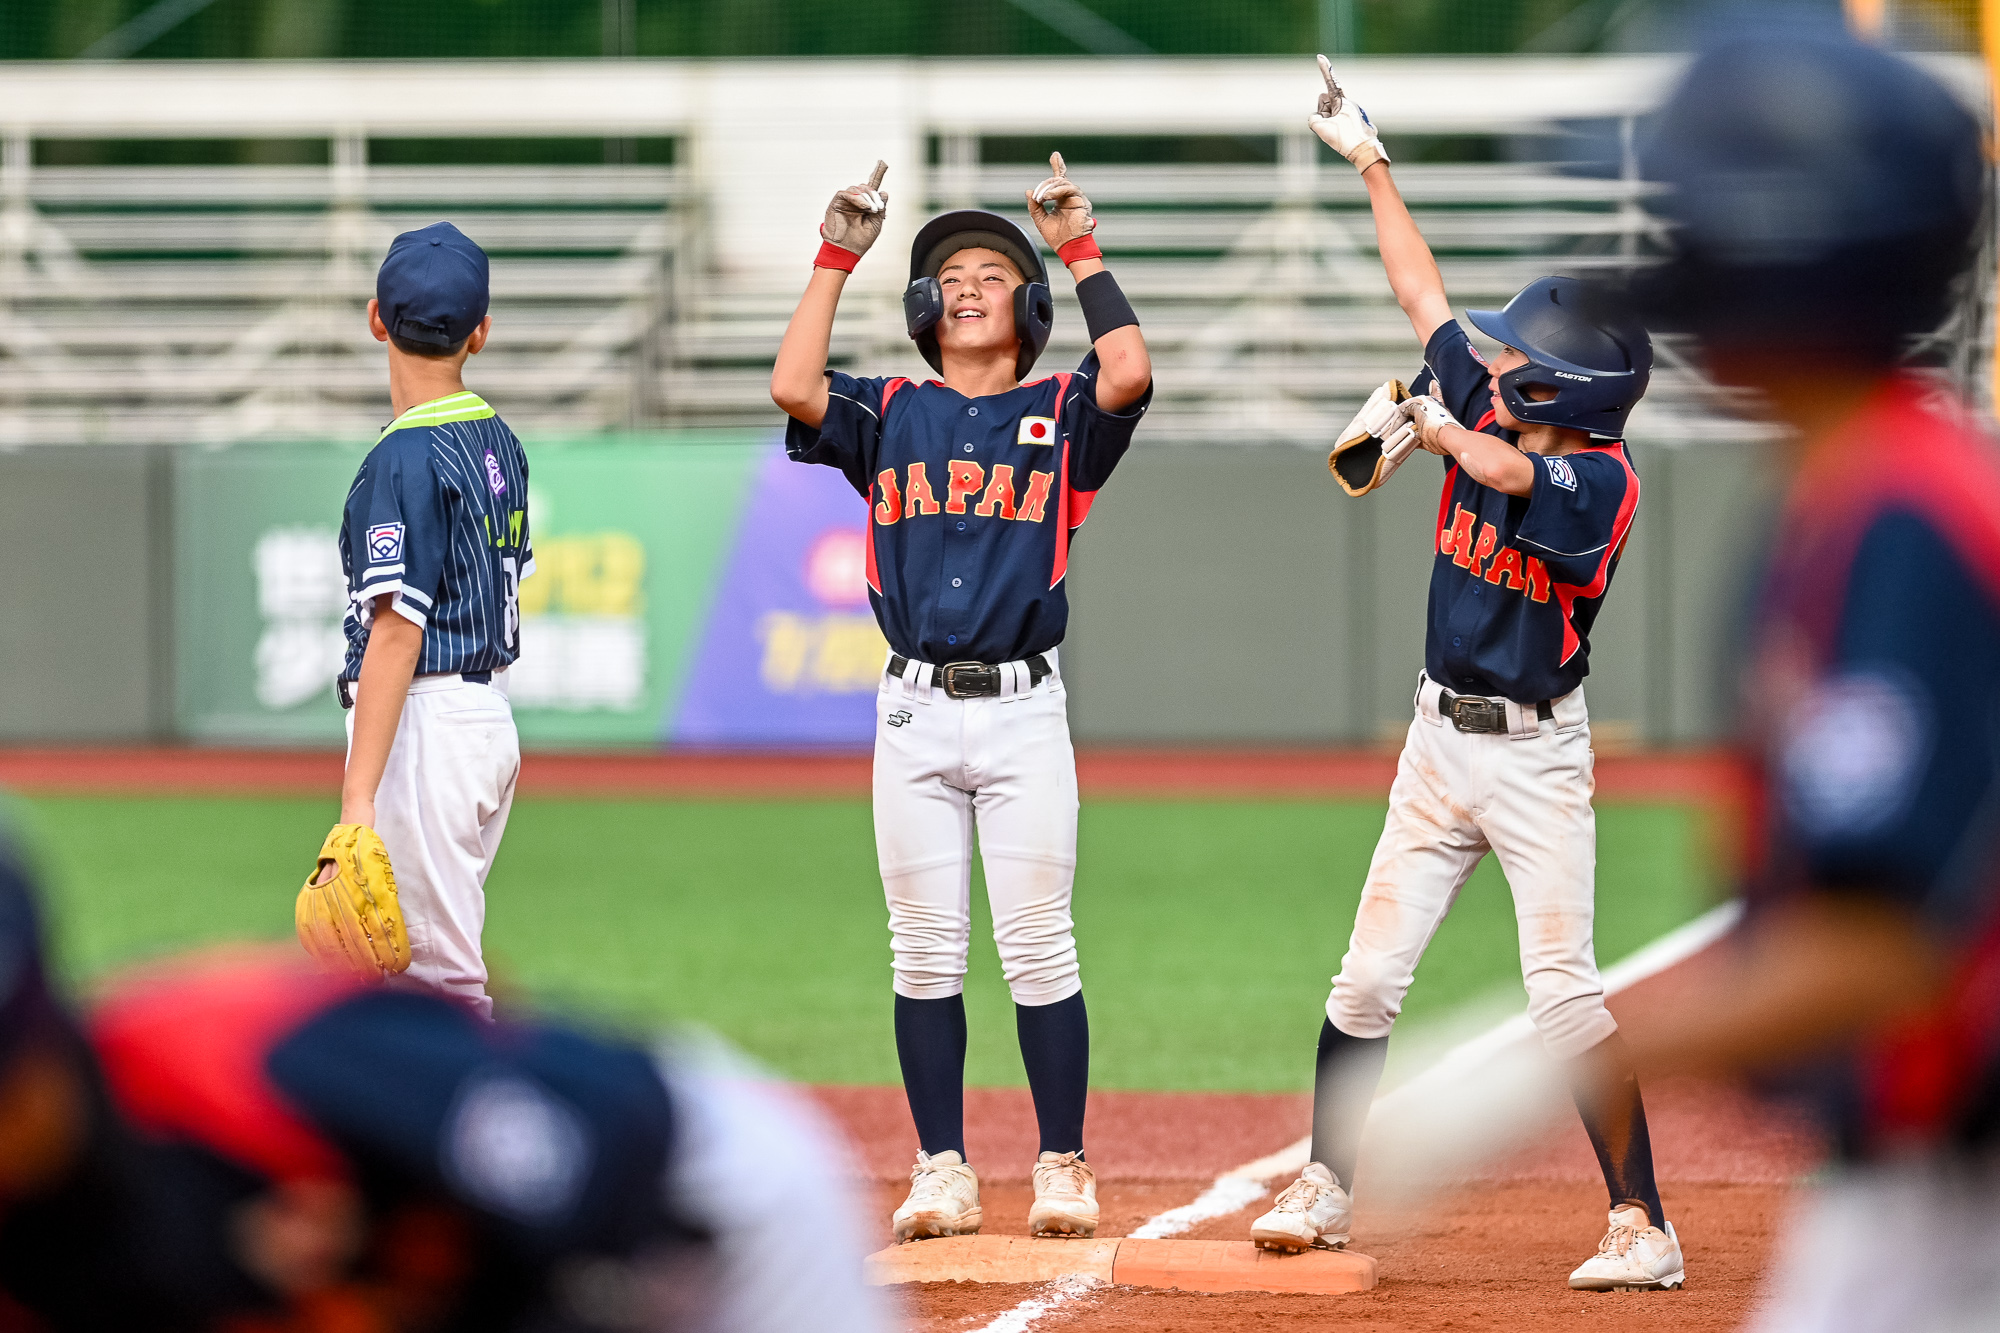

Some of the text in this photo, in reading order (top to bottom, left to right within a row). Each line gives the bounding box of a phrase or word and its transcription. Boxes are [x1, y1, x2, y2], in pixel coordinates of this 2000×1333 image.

[1554, 371, 1593, 382] EASTON
[875, 460, 1055, 526] JAPAN
[1441, 502, 1551, 604] JAPAN
